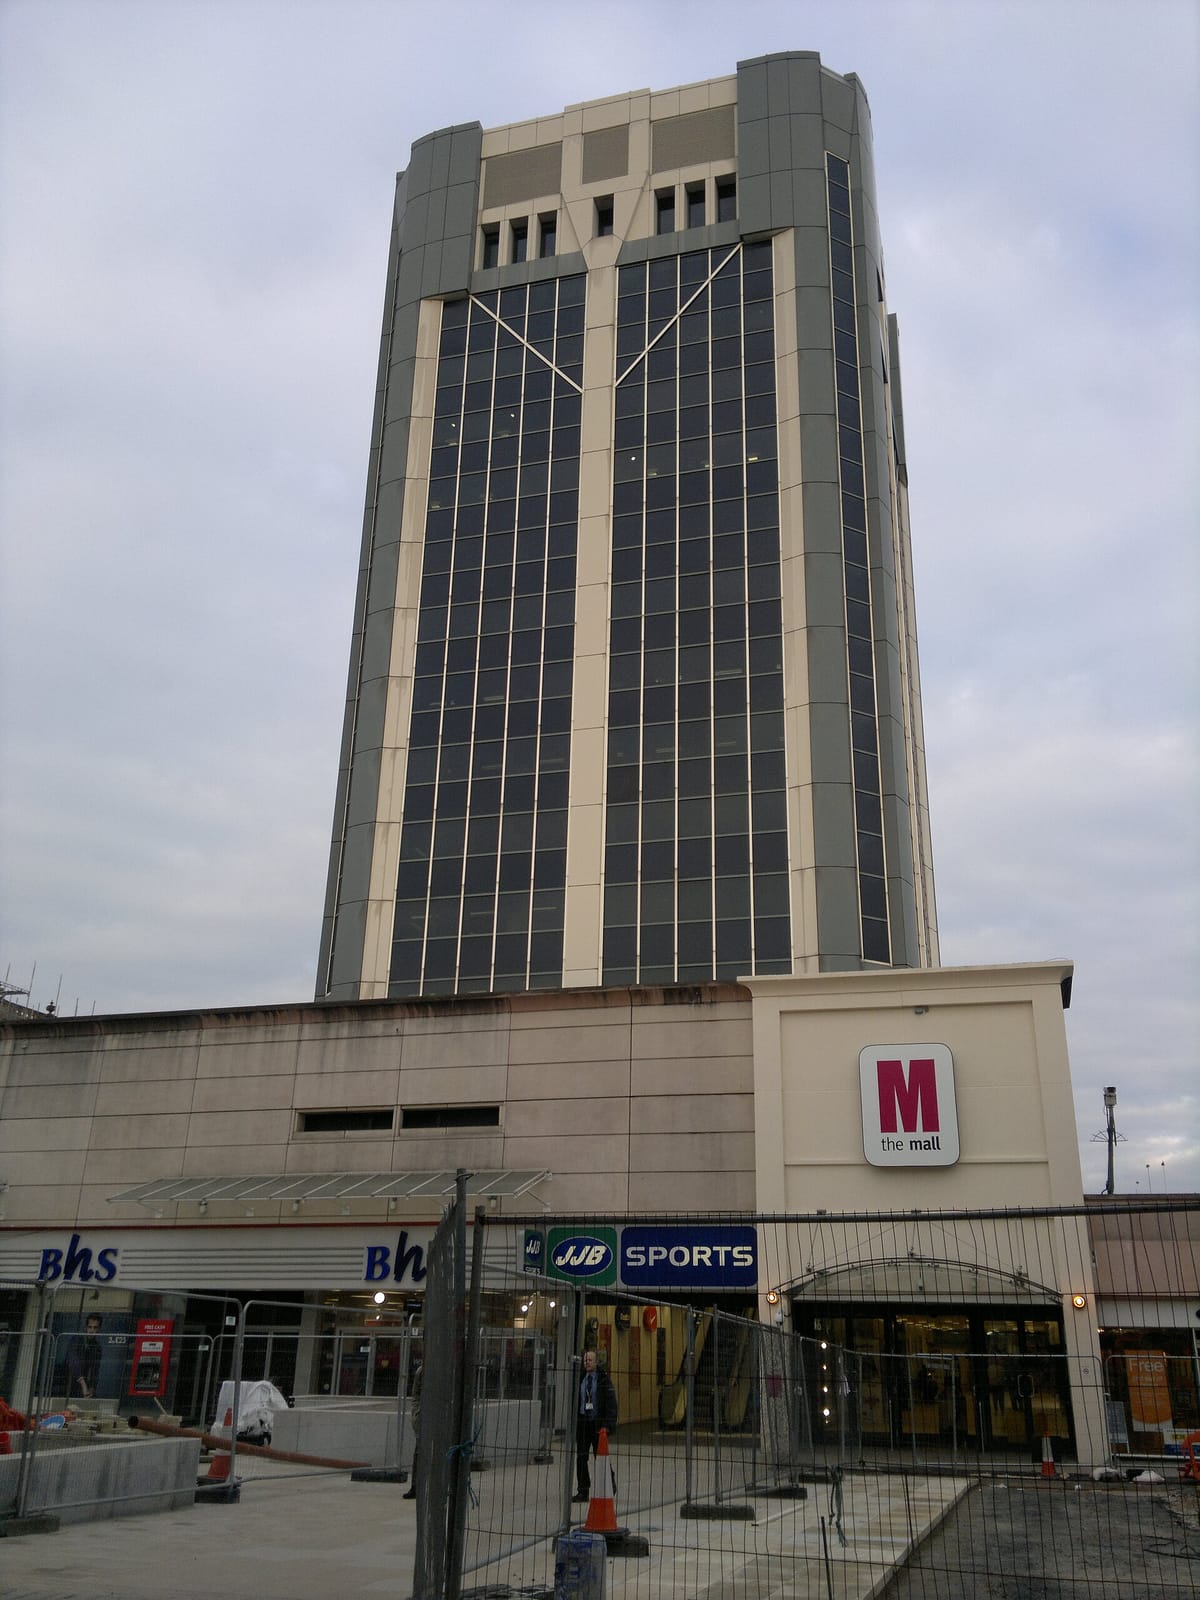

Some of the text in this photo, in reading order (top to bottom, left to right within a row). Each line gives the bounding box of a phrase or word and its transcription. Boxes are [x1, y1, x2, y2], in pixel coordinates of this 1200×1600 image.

[877, 1059, 940, 1133] M
[881, 1136, 941, 1151] the mall
[38, 1233, 119, 1281] Bhs
[364, 1230, 428, 1282] Bh
[526, 1240, 541, 1254] JJB
[555, 1245, 754, 1267] JJB SPORTS
[1129, 1359, 1164, 1373] Free
